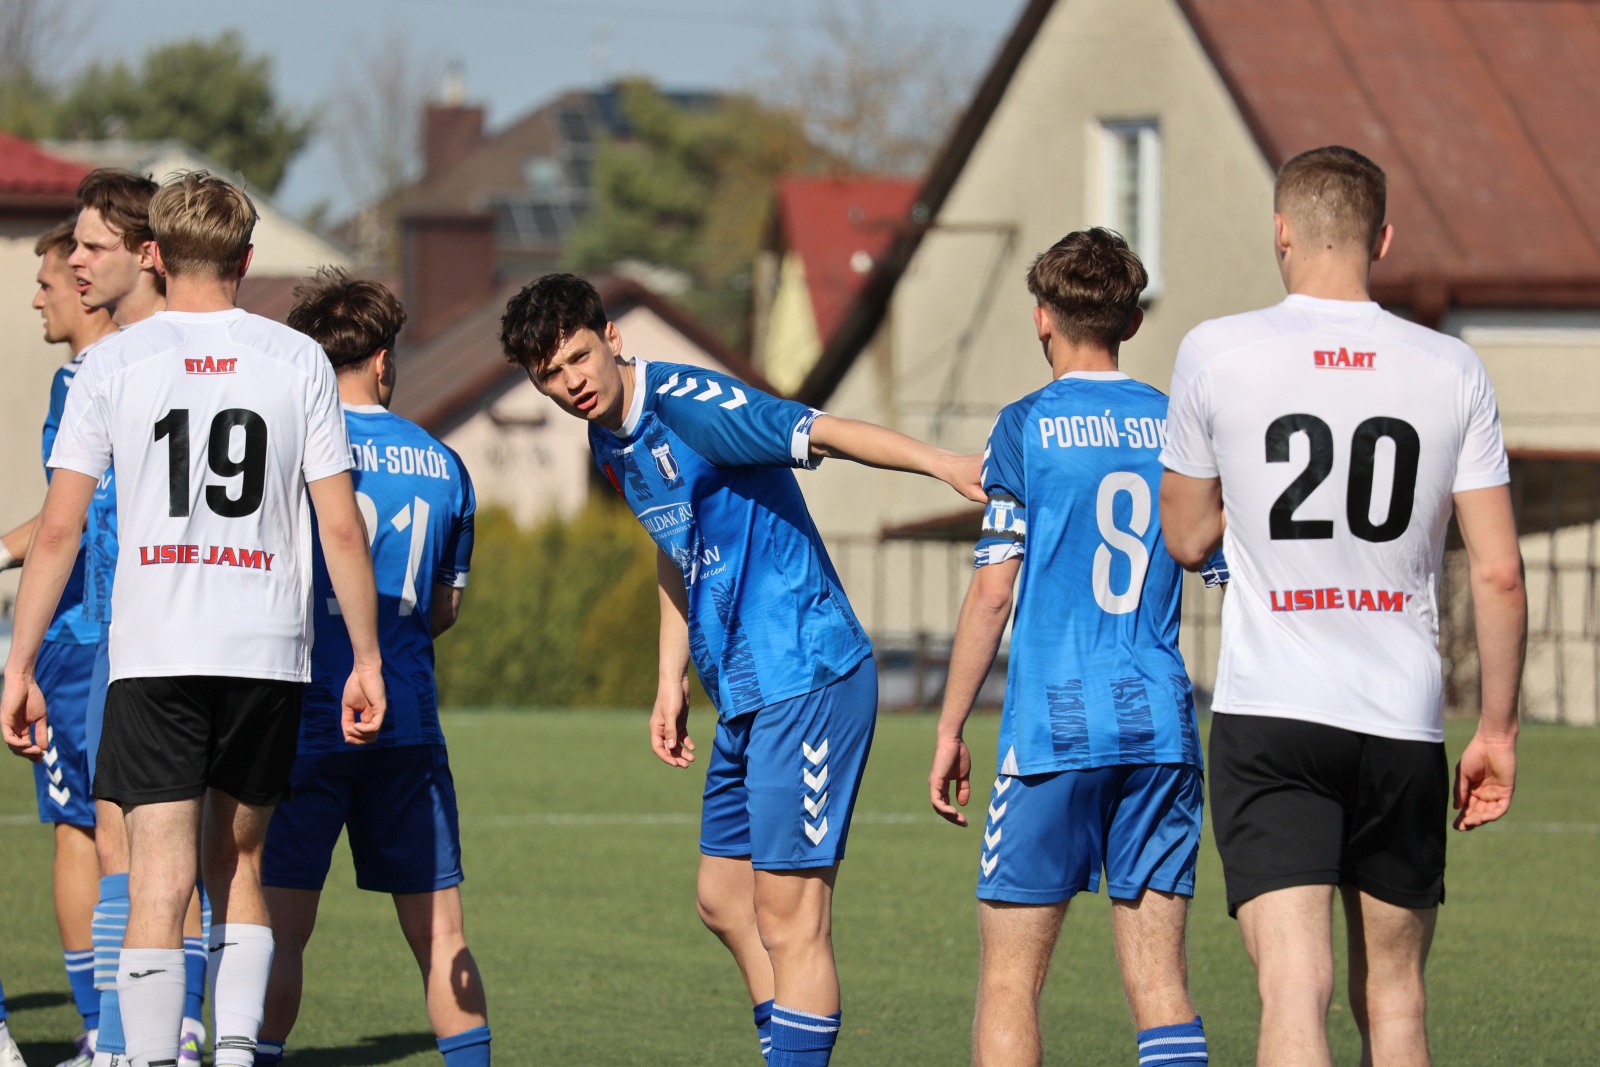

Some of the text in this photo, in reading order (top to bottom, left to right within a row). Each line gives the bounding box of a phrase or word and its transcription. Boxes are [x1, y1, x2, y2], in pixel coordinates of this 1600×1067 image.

[184, 355, 237, 375] START
[1314, 347, 1376, 369] START
[154, 408, 268, 518] 19
[1265, 413, 1420, 543] 20
[1092, 471, 1151, 615] 8
[139, 544, 275, 571] LISIE JAMY
[1269, 587, 1413, 612] LISIE JAM
